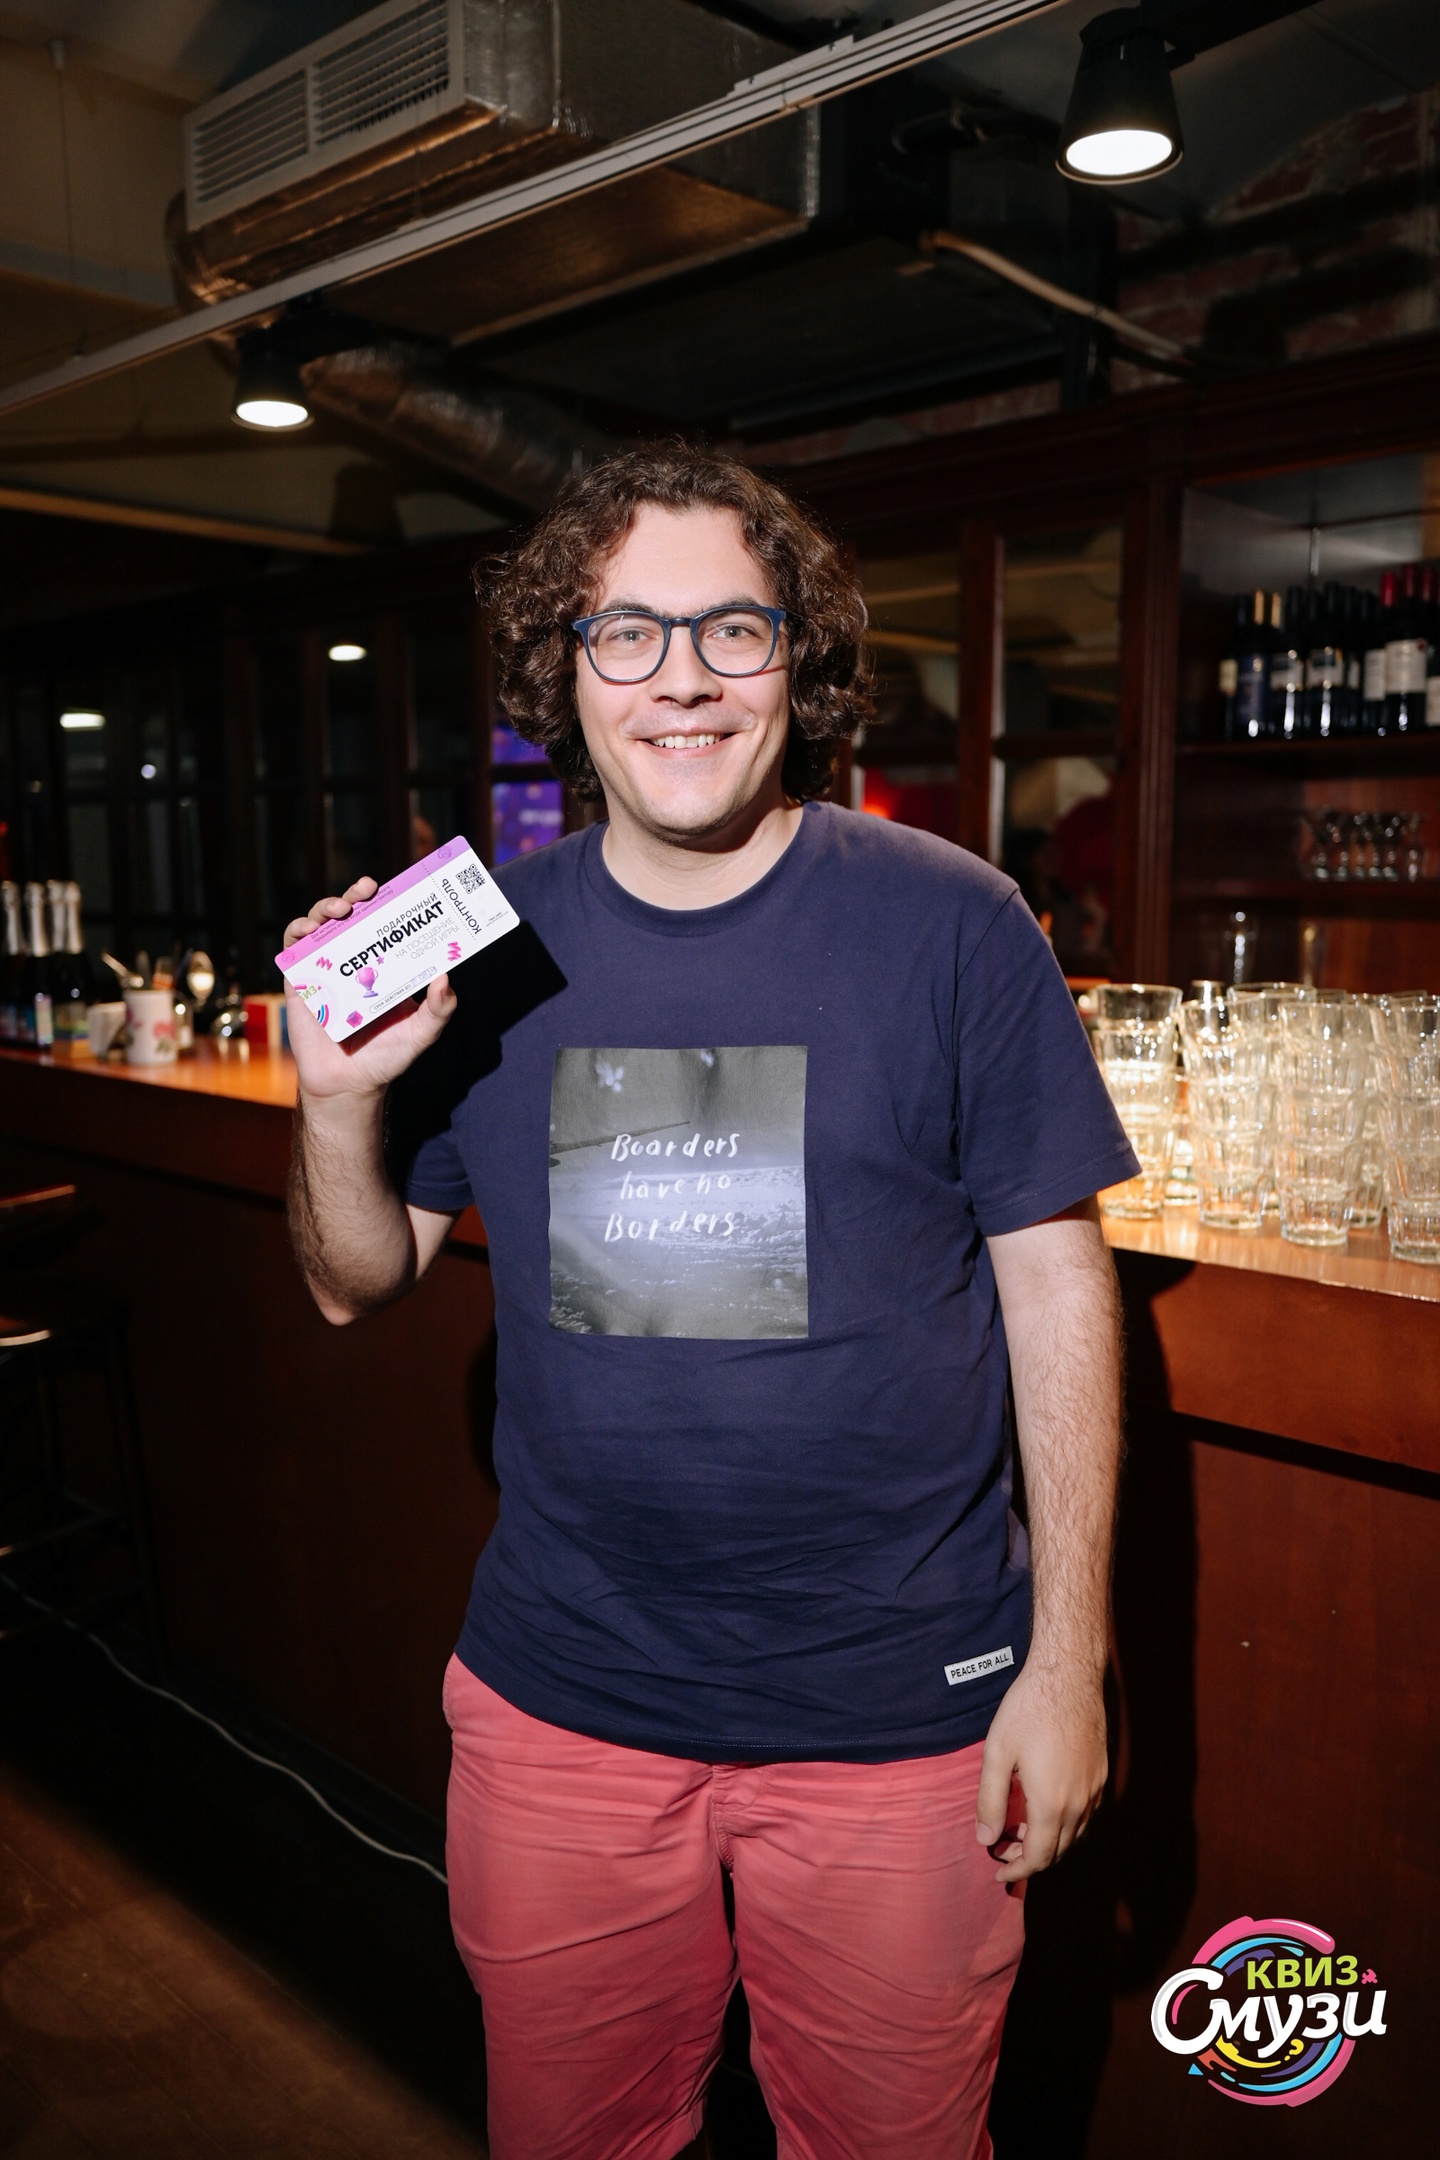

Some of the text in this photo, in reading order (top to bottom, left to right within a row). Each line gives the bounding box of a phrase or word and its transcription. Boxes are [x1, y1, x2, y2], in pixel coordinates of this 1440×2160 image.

[376, 892, 438, 937] ПОДАРОЧНЫЙ
[441, 877, 482, 934] КОНТРОЛЬ
[339, 900, 445, 977] СЕРТИФИКАТ
[394, 916, 455, 959] НА ПОСЕЩЕНИЕ
[409, 924, 460, 961] ОДНОЙ ИГРЫ
[610, 1132, 740, 1162] Boarders
[620, 1170, 732, 1200] have no
[604, 1210, 736, 1243] Borders
[950, 1654, 1009, 1678] PEACE FOR ALL
